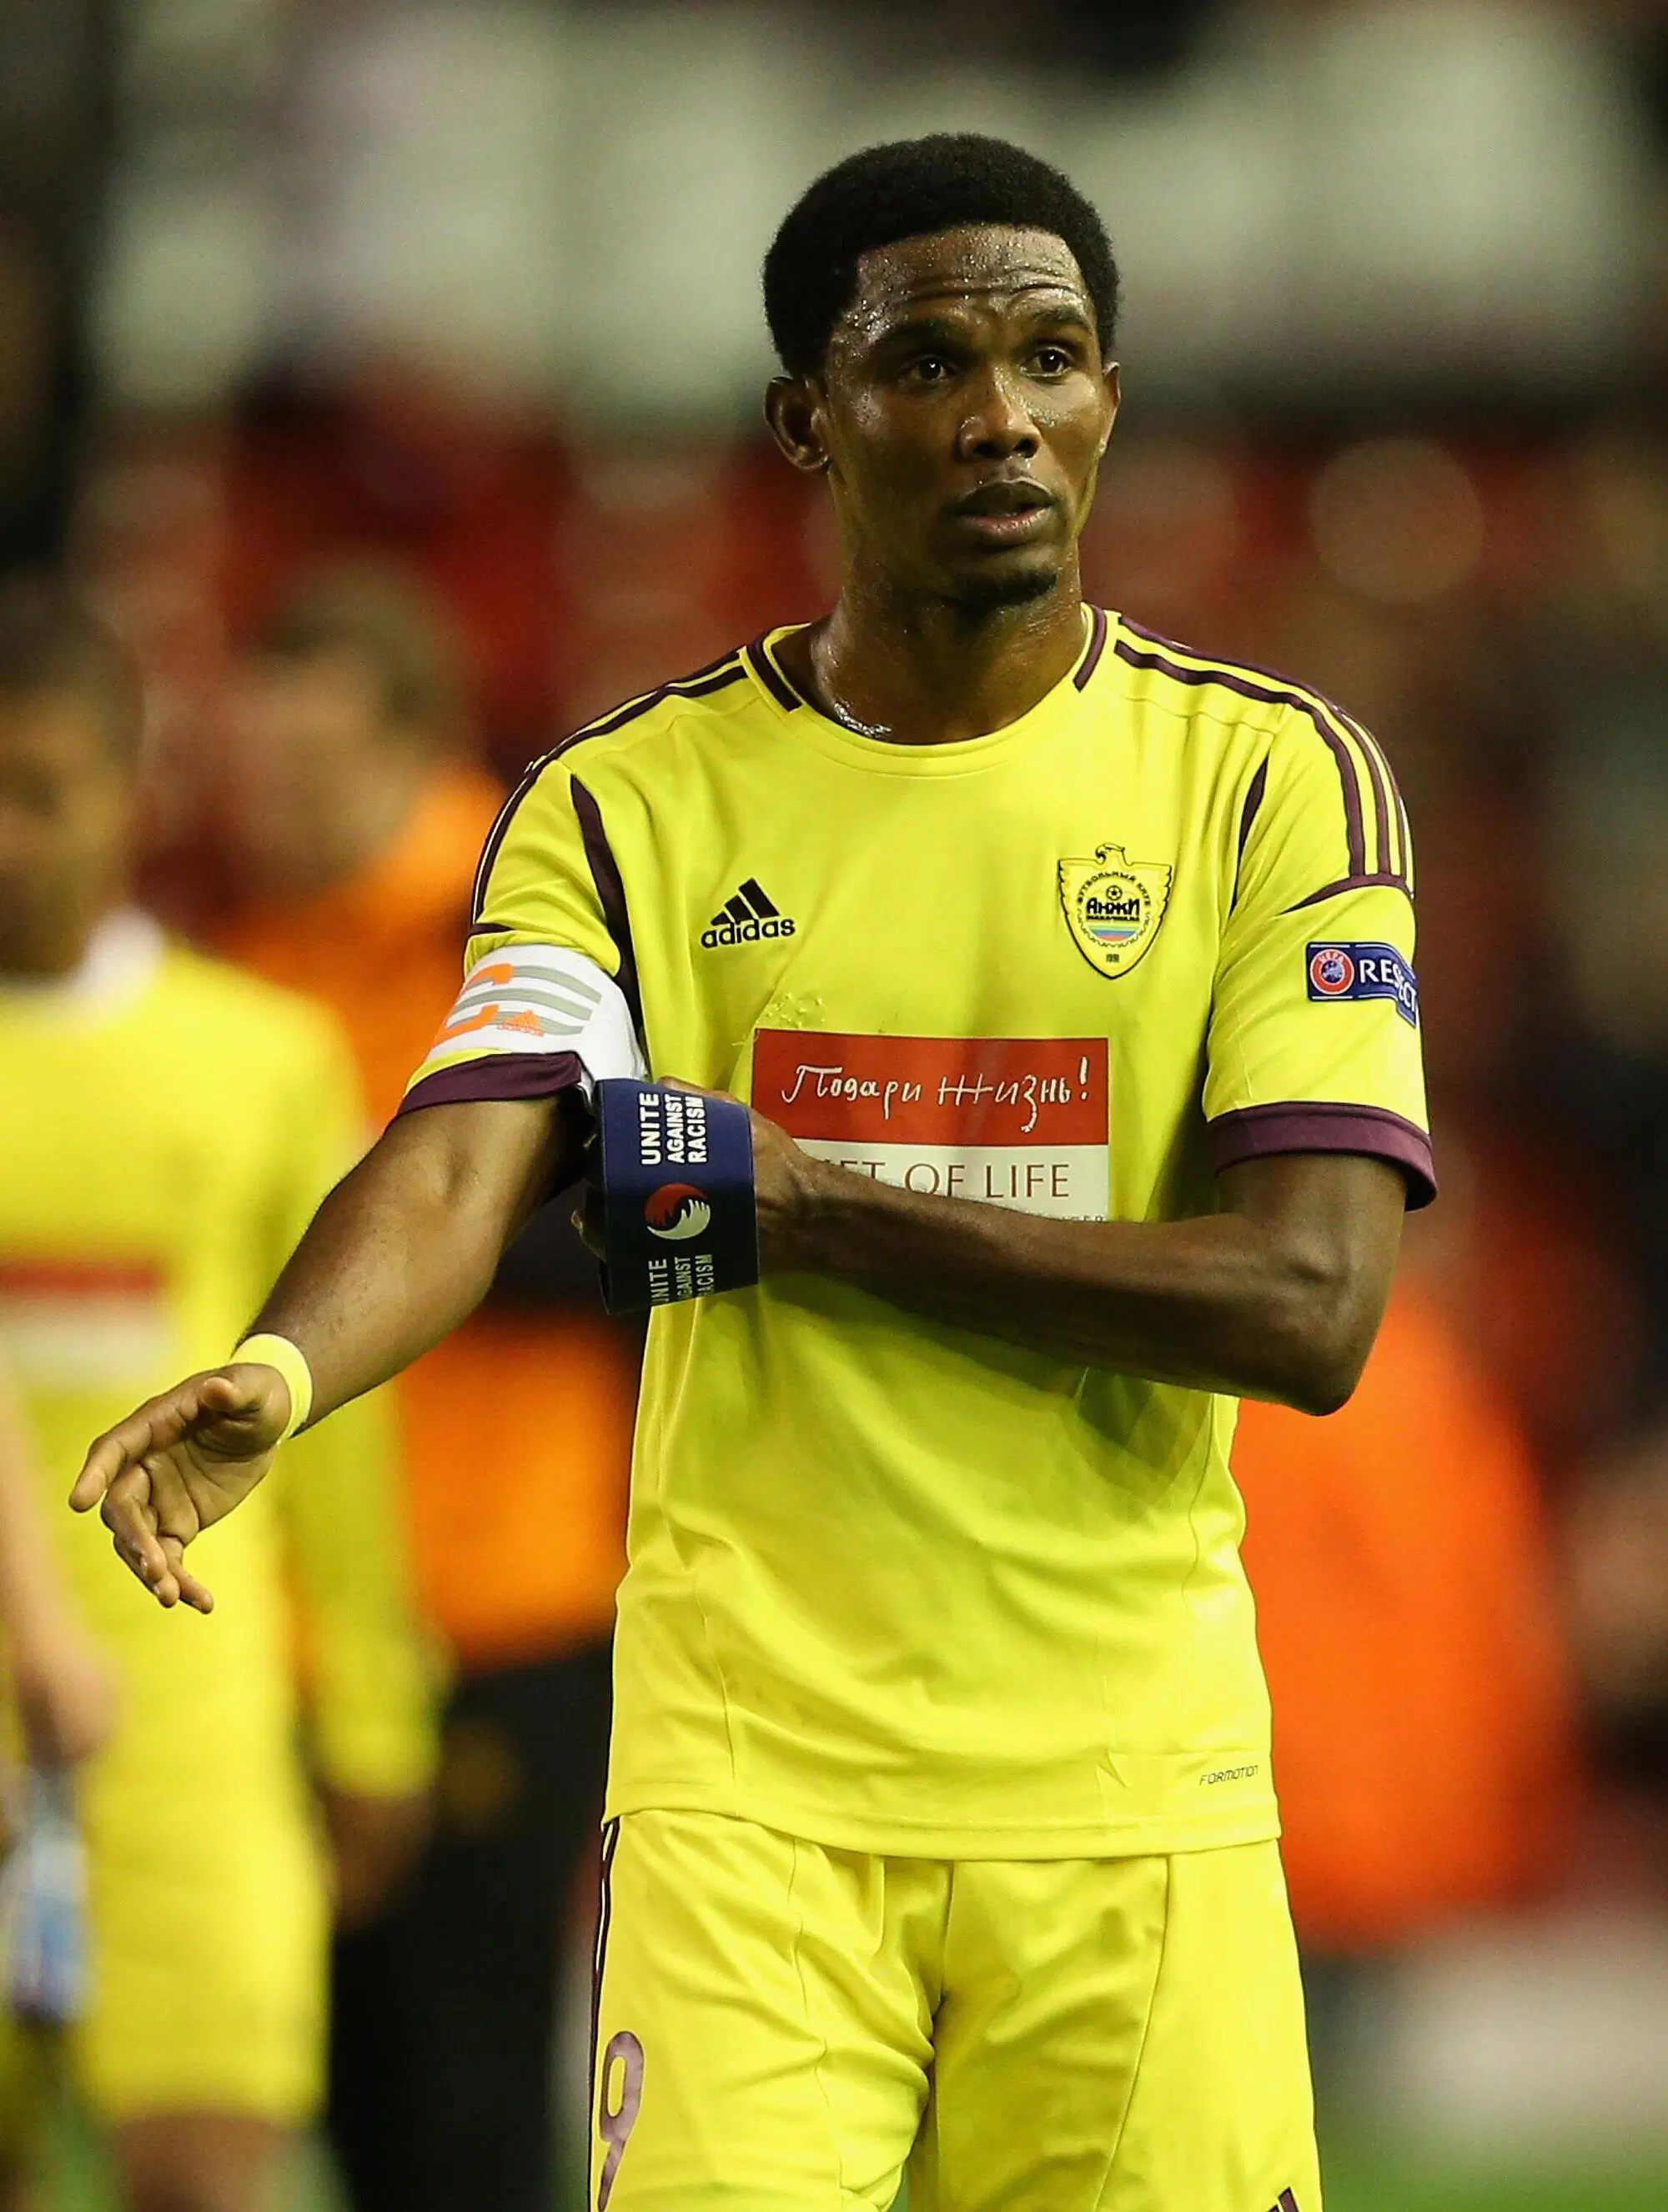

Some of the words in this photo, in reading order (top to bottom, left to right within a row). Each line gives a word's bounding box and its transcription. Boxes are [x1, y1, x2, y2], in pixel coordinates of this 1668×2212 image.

[701, 918, 796, 949] adidas
[1318, 951, 1345, 964] UEFA
[781, 1064, 922, 1120] Подари
[639, 1092, 661, 1165] UNITE
[665, 1094, 685, 1164] AGAINST
[686, 1096, 707, 1163] RACISM
[904, 1163, 964, 1197] OF
[986, 1164, 1069, 1198] LIFE
[674, 1256, 692, 1298] GAINST
[598, 2030, 645, 2212] 9
